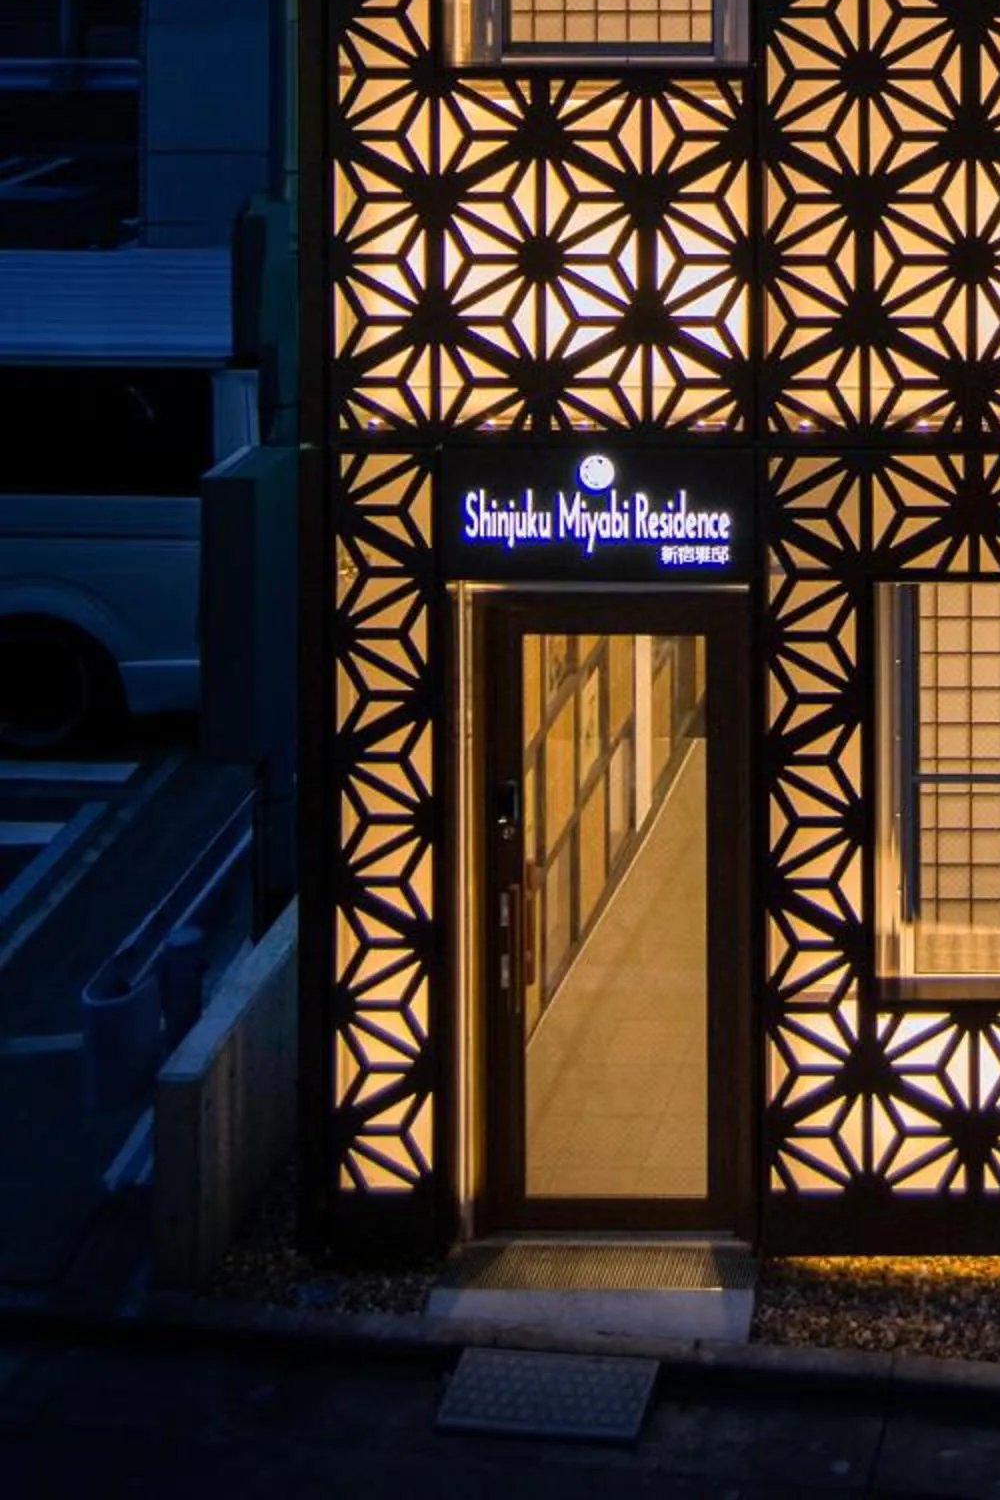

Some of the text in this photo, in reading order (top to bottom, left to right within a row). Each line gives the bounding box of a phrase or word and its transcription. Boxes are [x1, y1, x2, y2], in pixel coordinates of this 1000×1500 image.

[465, 489, 731, 552] Shinjuku Miyabi Residence
